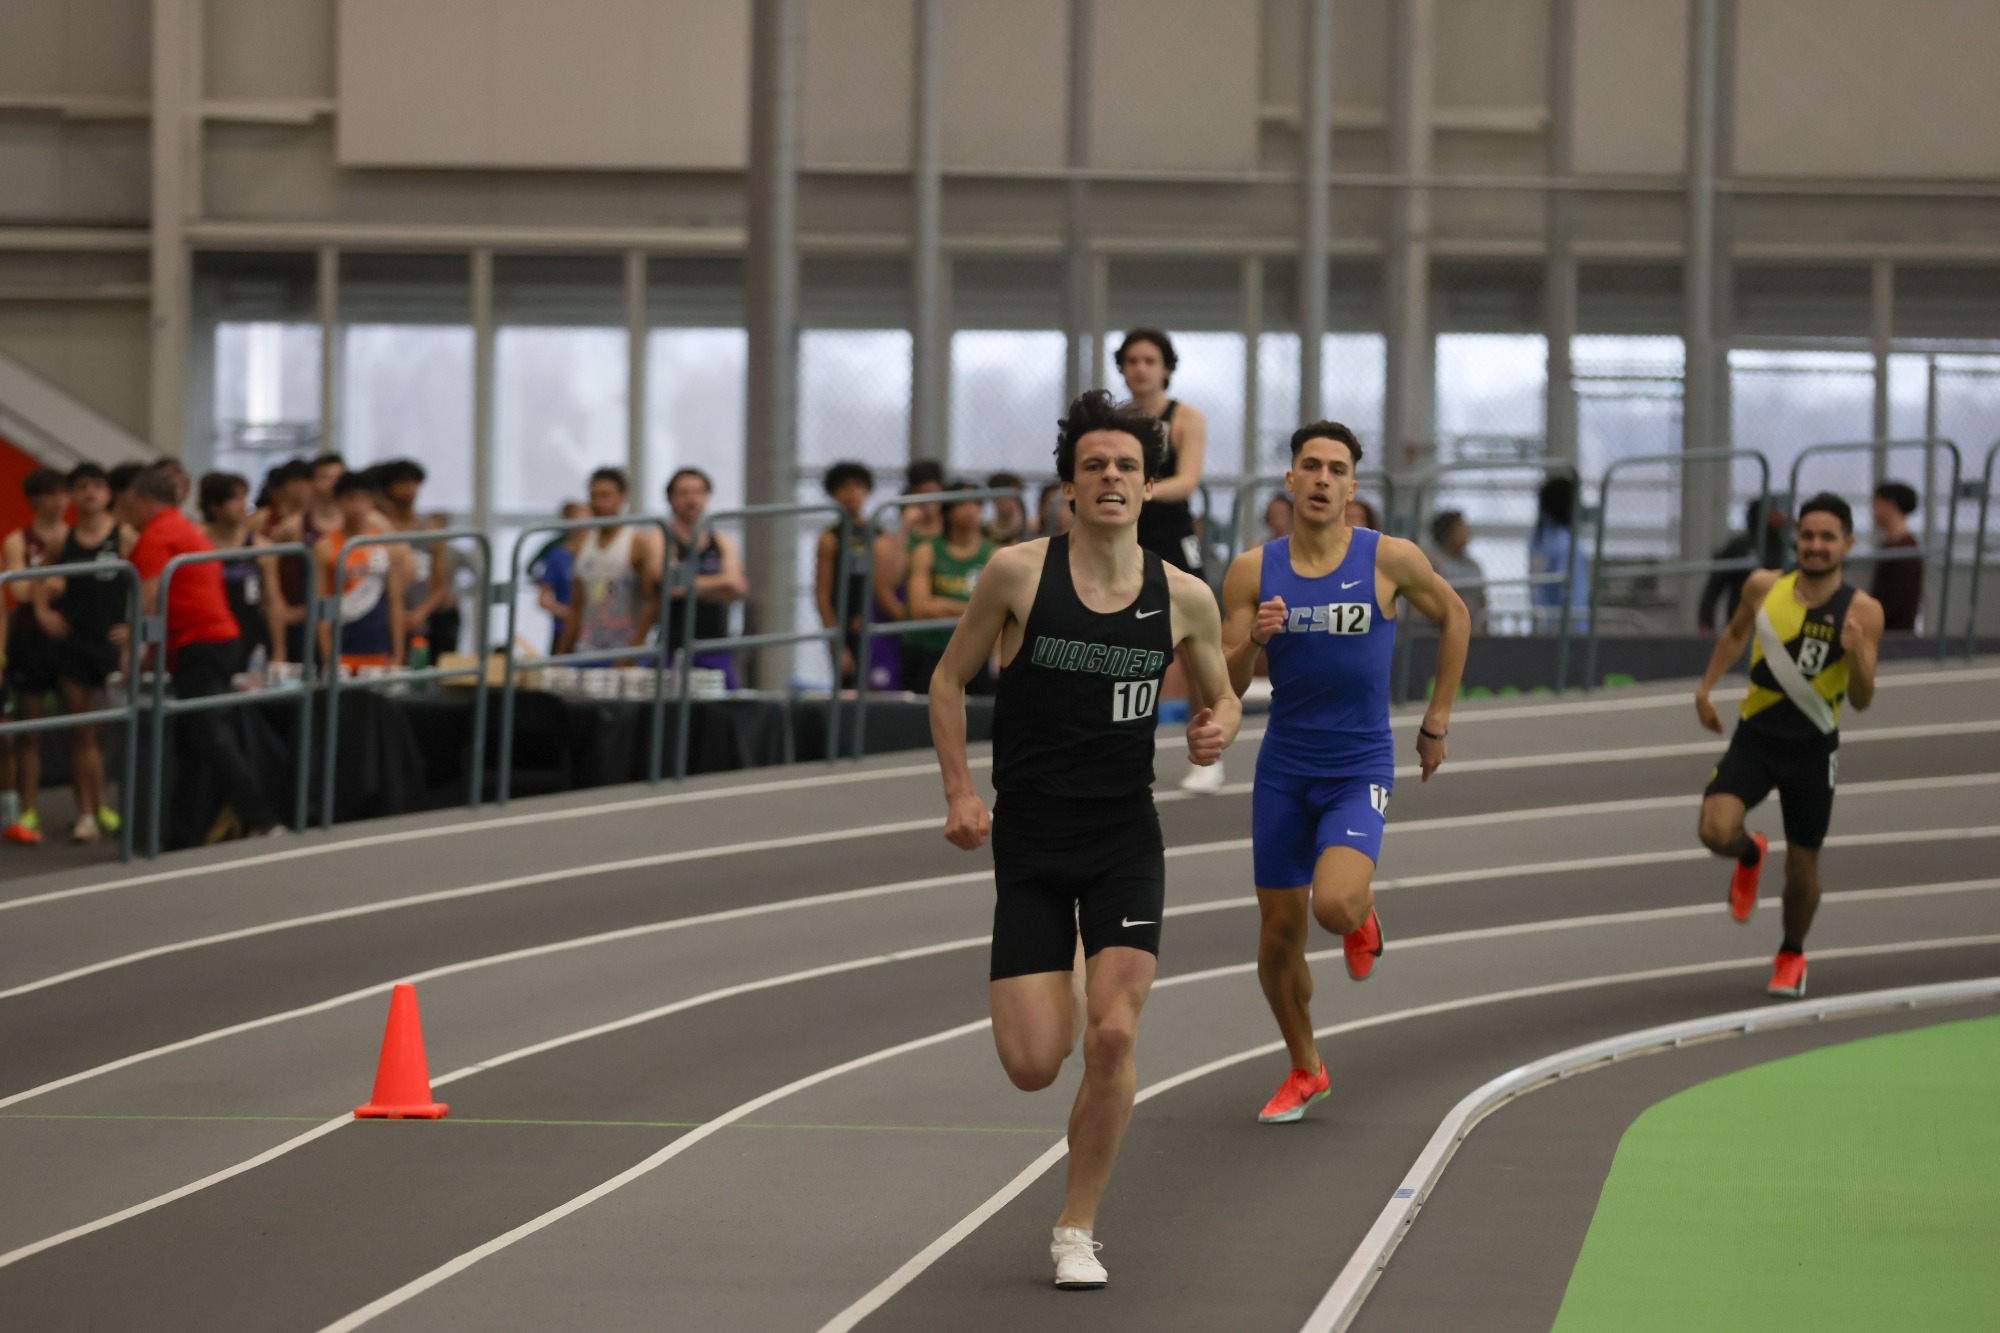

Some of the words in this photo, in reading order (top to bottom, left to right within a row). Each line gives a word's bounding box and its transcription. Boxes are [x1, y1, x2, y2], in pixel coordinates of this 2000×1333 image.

[1332, 605, 1364, 632] 12
[1031, 635, 1165, 677] WAGNER
[1801, 641, 1822, 670] 3
[1118, 682, 1152, 718] 10
